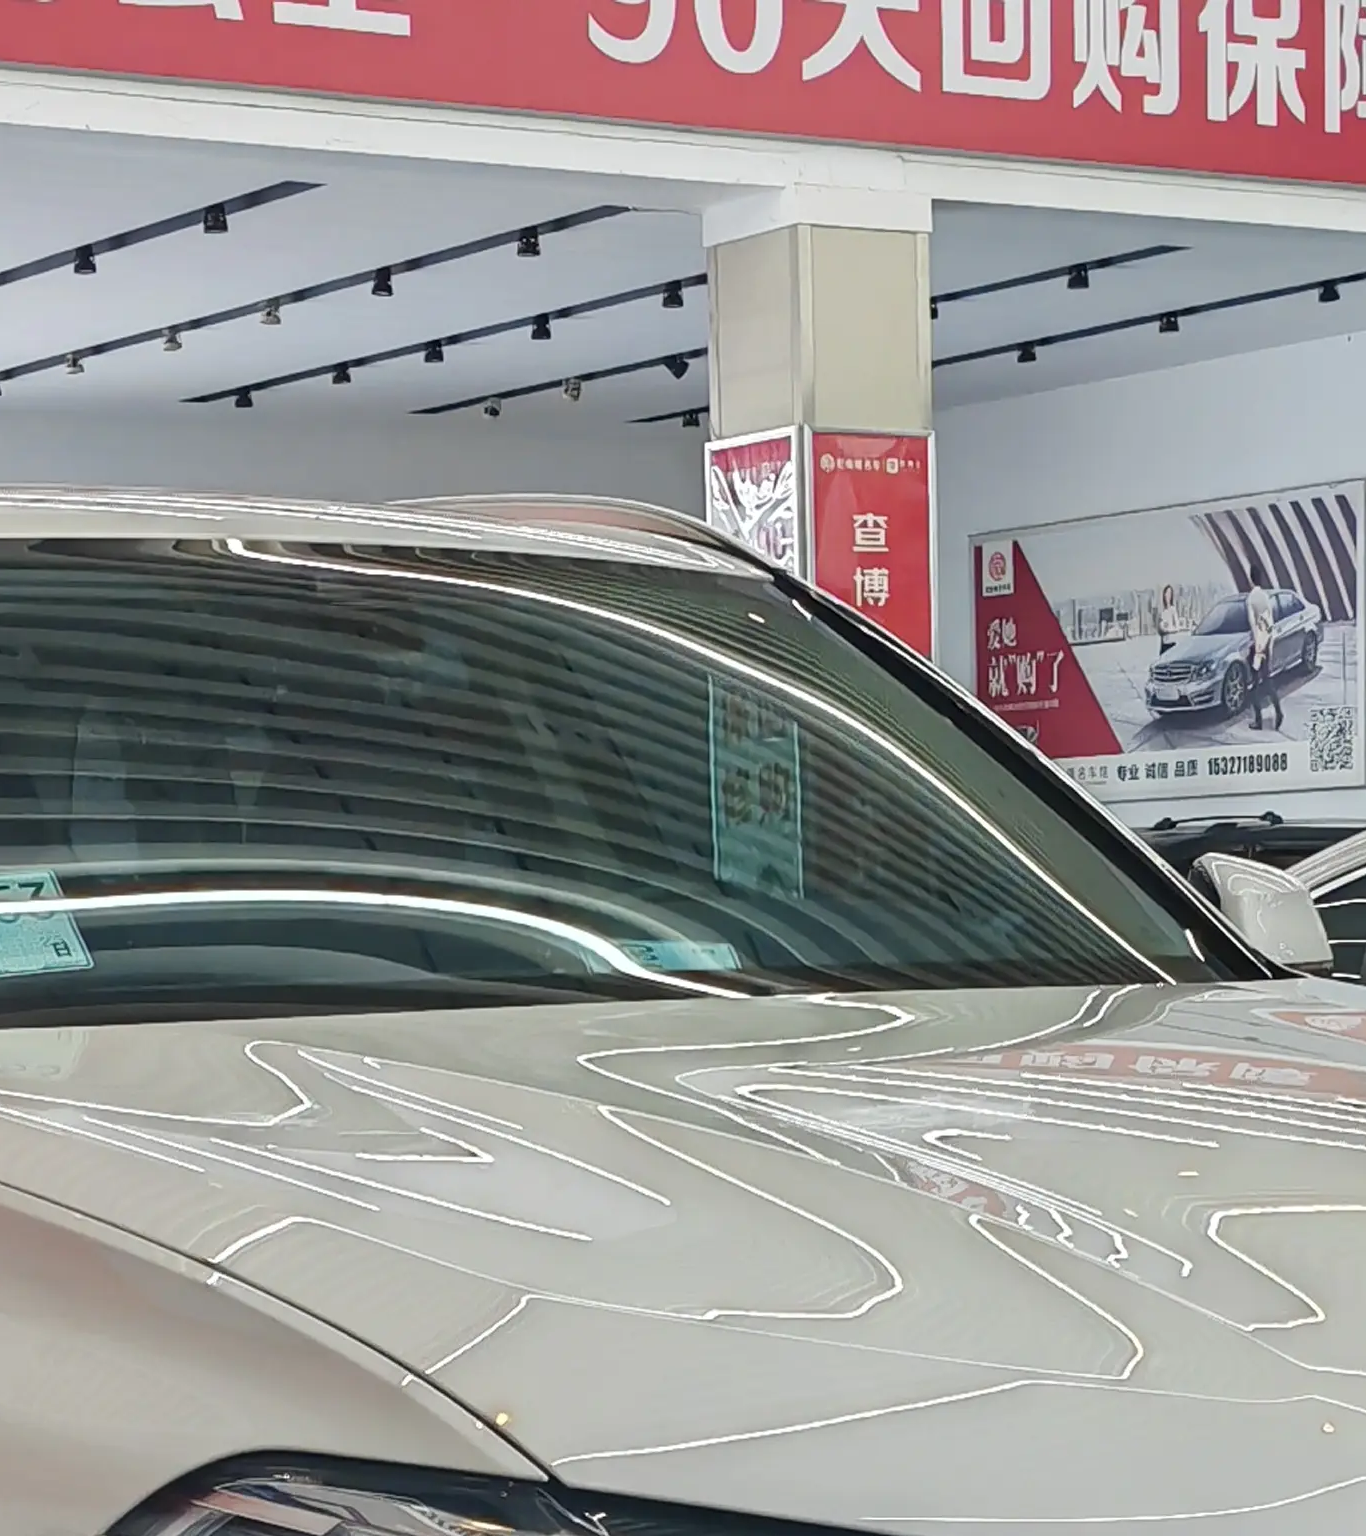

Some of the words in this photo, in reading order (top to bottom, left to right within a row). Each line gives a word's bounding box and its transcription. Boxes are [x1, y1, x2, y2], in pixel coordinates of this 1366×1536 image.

[852, 512, 889, 607] 查博
[1117, 764, 1140, 781] 专业
[1145, 762, 1168, 780] 诚信
[1175, 759, 1198, 777] 品质
